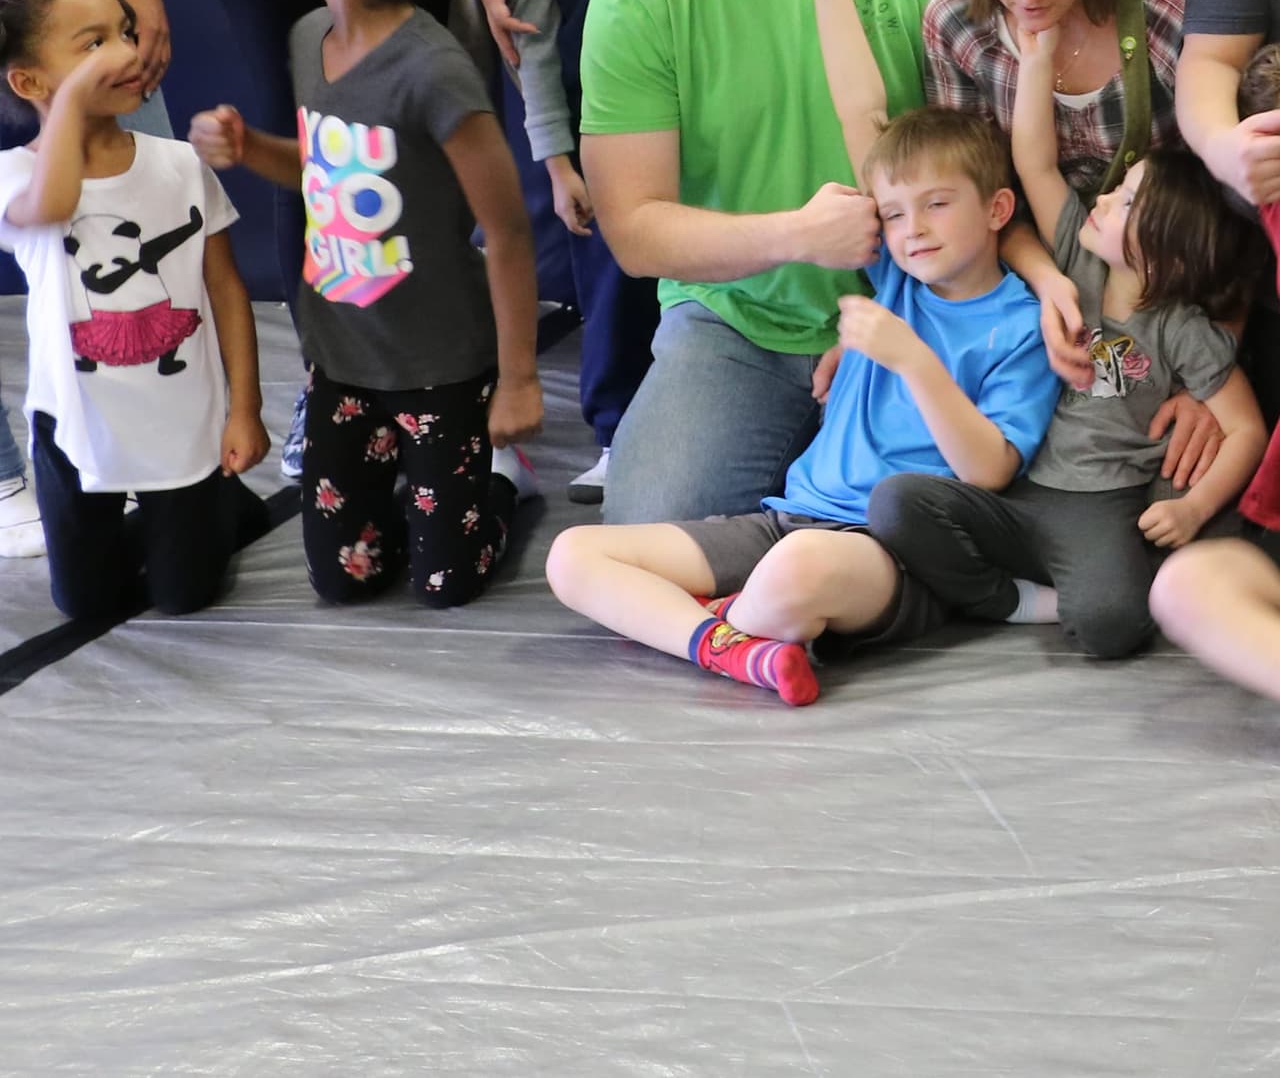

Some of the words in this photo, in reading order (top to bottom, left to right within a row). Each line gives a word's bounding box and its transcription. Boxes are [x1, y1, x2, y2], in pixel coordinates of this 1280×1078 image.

[298, 106, 399, 172] YOU
[302, 162, 403, 233] GO
[307, 228, 414, 278] GIRL!
